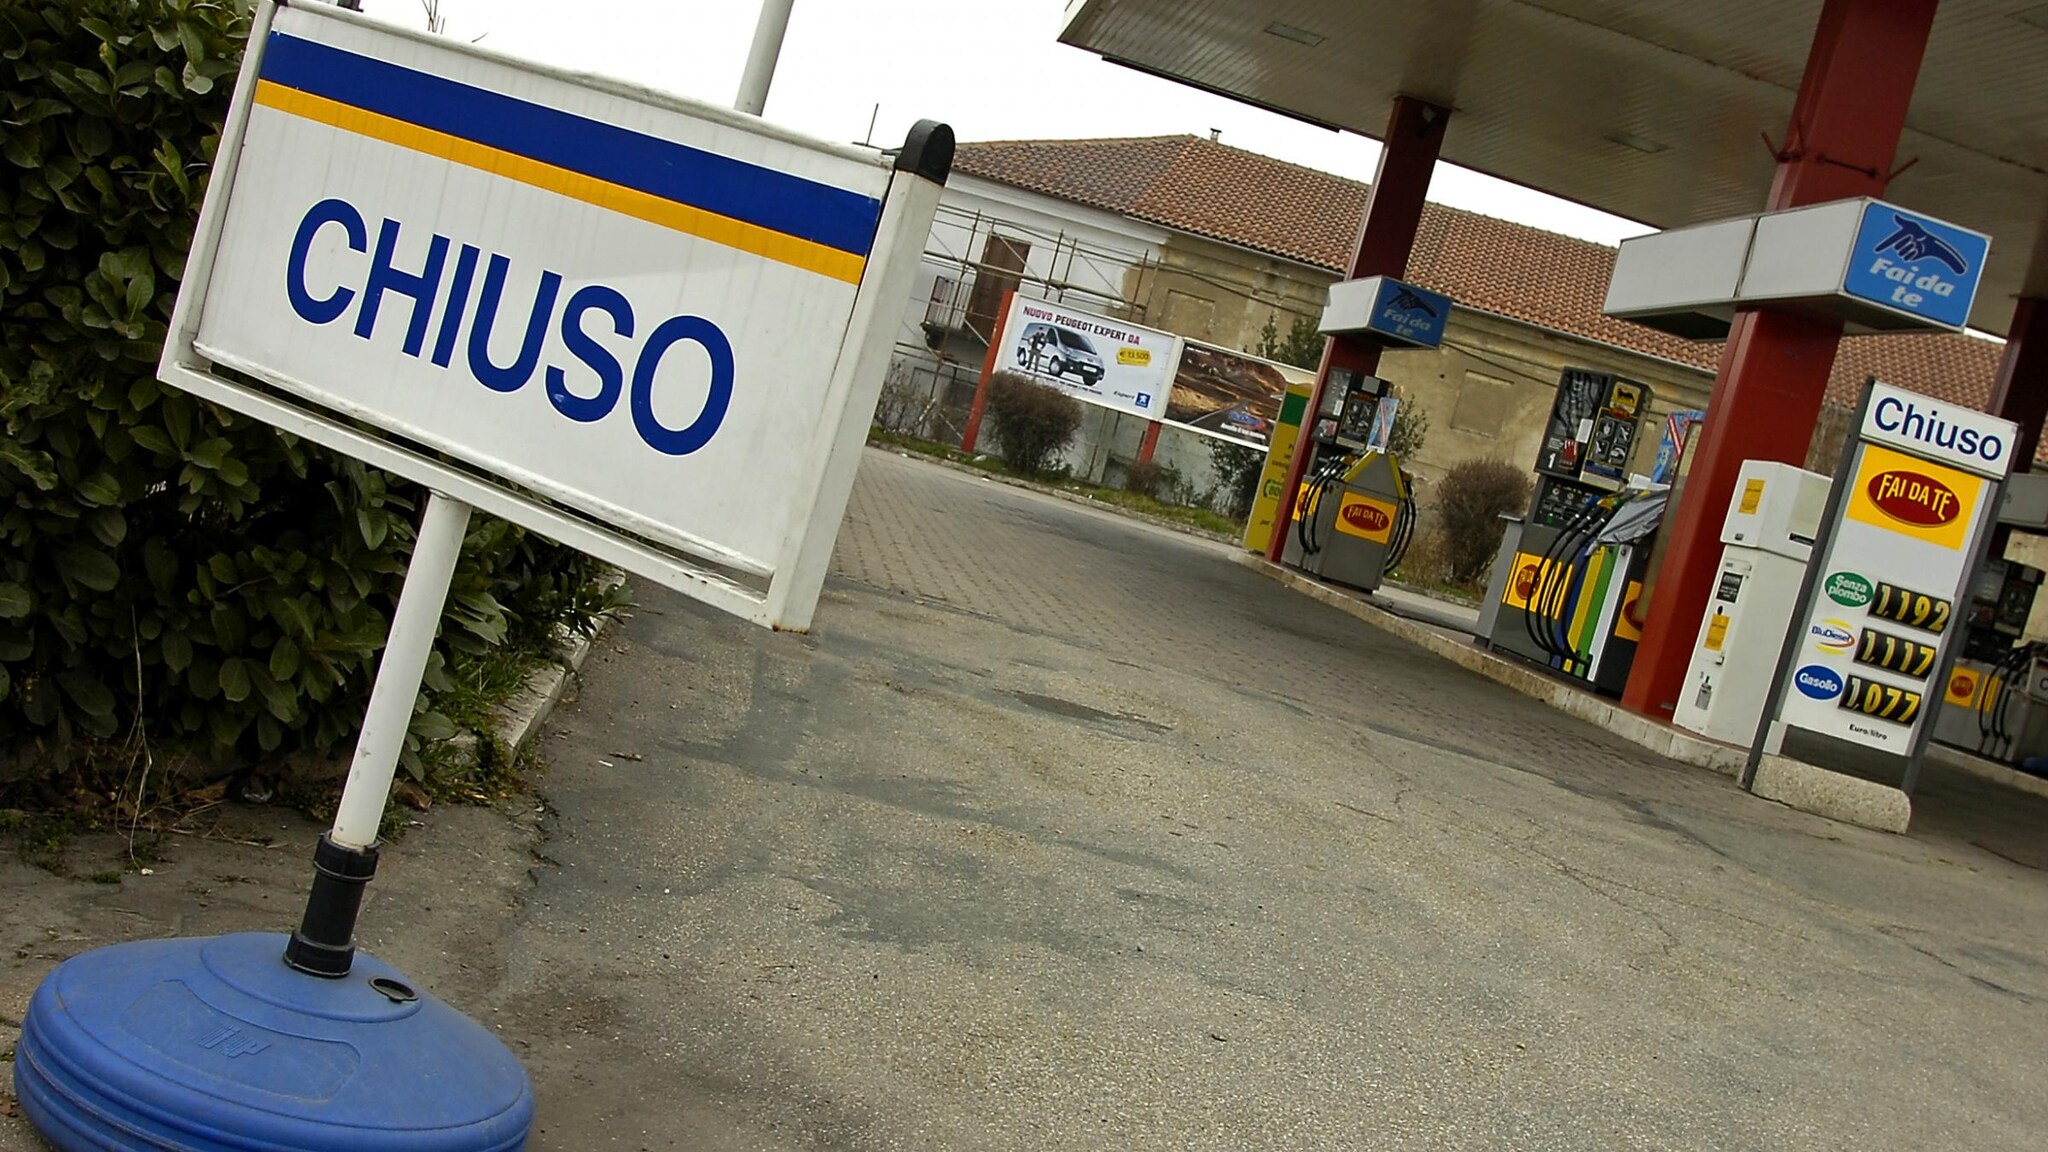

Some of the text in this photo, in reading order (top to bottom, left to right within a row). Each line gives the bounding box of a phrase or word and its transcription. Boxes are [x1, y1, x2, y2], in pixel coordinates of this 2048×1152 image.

[1869, 258, 1955, 298] Fai da
[1891, 285, 1924, 308] te
[286, 197, 735, 455] CHIUSO
[1023, 306, 1141, 345] NUOVO PEUGEOT EXPERT DA
[1383, 309, 1431, 331] Fai da
[1395, 324, 1413, 337] te
[1340, 385, 1348, 397] 3
[1874, 396, 2002, 461] Chiuso
[1548, 453, 1556, 469] 1
[1877, 473, 1953, 521] FAI DA TE
[1347, 505, 1386, 528] FAI DA TE
[1835, 575, 1867, 594] Senza
[1875, 584, 1950, 632] 1,192
[1811, 625, 1850, 642] BluDiesel
[1861, 630, 1935, 676] 1,117
[1799, 672, 1838, 692] Gasolio
[1847, 677, 1921, 722] 1,077
